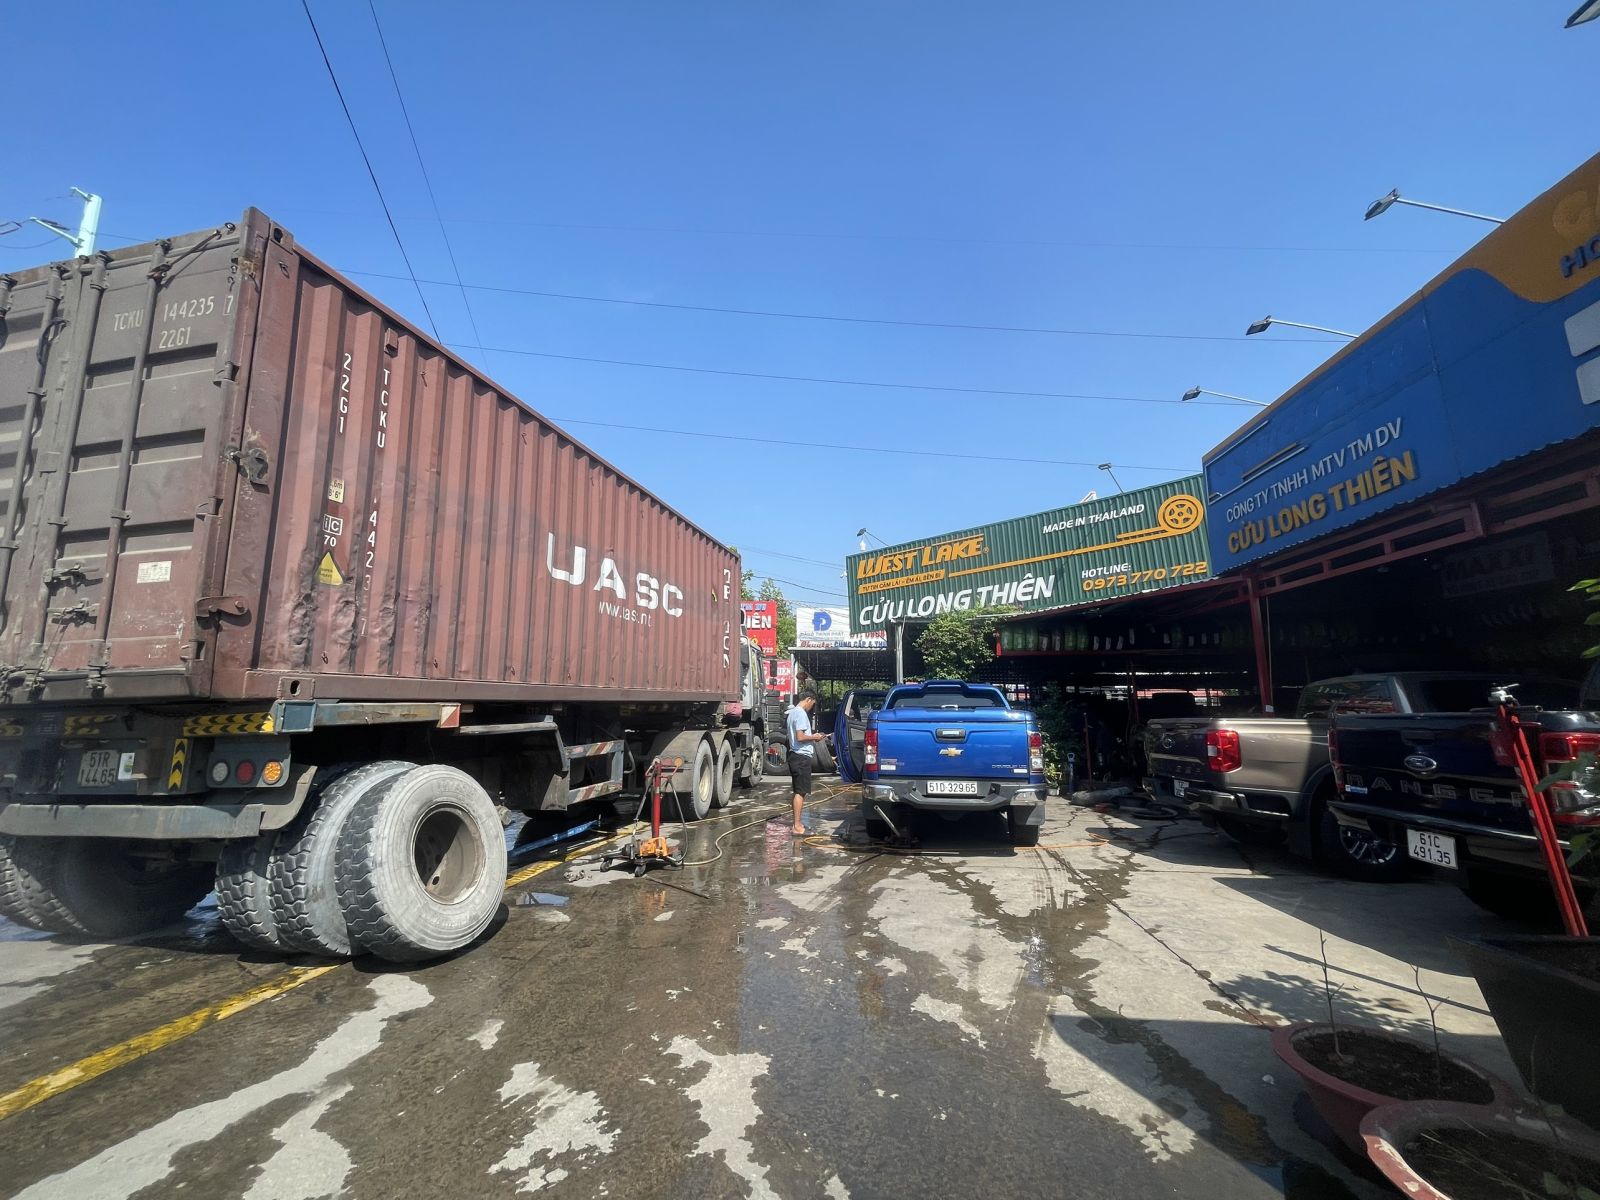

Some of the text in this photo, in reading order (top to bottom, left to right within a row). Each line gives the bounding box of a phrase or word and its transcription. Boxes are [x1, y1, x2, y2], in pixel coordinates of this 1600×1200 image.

[114, 309, 144, 332] TCKU
[163, 296, 215, 322] 144235
[159, 326, 191, 349] 22G1
[1226, 417, 1401, 523] CÔNG TY TNHH MTV TM DV
[1268, 493, 1327, 538] LONG
[1328, 450, 1418, 512] THIÊN
[1043, 504, 1145, 534] MADE IN THAILAND
[324, 535, 336, 547] 70
[857, 536, 984, 579] WEST LAKE
[1081, 562, 1132, 578] HOTLINE:
[547, 531, 684, 618] UASC
[1082, 561, 1208, 591] 0973 770 722
[859, 572, 1055, 626] CỬU LONG THIÊN
[90, 751, 111, 768] 51R
[1413, 845, 1451, 865] 491.35
[1420, 832, 1440, 848] 61C
